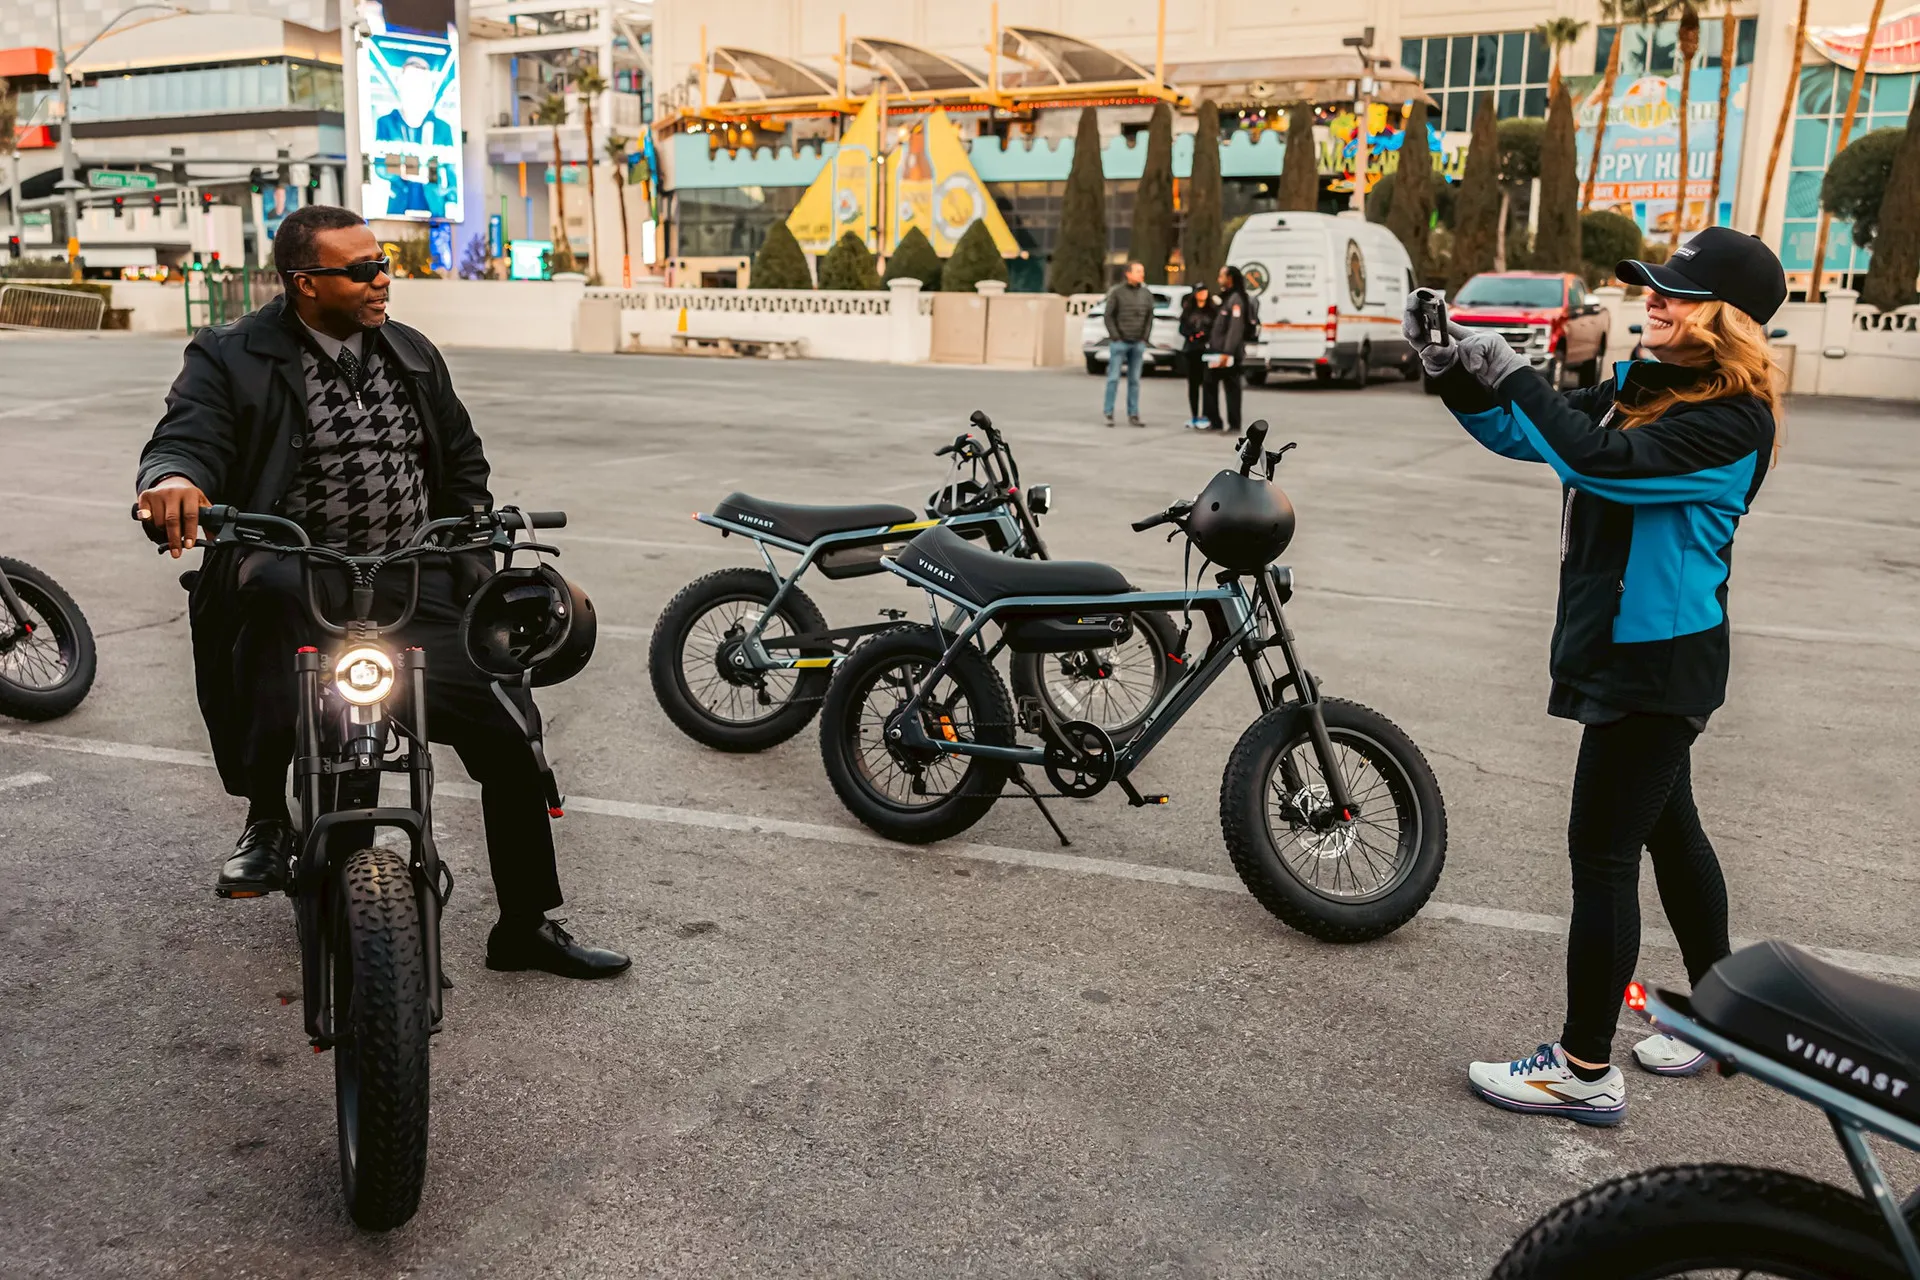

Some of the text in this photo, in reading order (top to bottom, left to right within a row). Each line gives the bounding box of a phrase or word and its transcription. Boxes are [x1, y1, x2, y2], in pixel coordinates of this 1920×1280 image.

[738, 513, 774, 529] VINFAST
[919, 558, 955, 582] VINFAST
[1786, 1033, 1909, 1098] VINFAST
